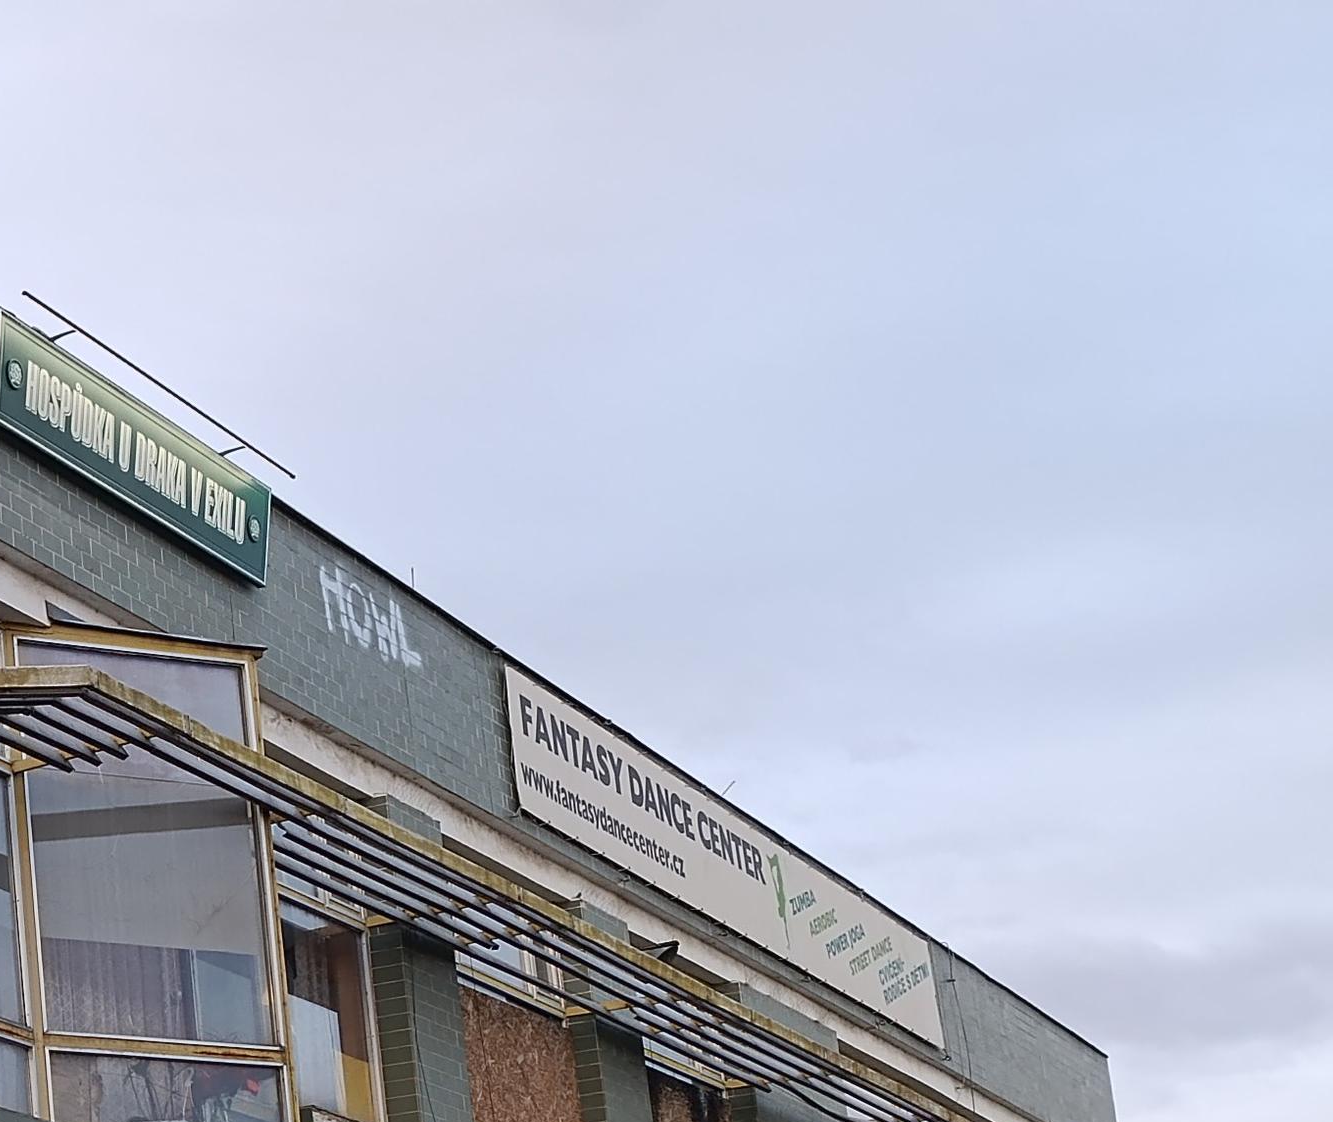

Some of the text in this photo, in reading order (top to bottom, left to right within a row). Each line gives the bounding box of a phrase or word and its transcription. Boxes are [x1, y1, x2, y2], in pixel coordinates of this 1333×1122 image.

[25, 360, 247, 546] HOSPŮDKA U DRAKA V EXILU
[318, 564, 423, 668] HOWL
[518, 693, 767, 886] FANTASY DANCE CENTER
[520, 761, 687, 879] www.fantasydancecenter.cz
[789, 889, 817, 916] ZUMBA
[808, 908, 838, 937] AEROBIC
[825, 932, 849, 960] POWER
[848, 936, 893, 977] STREET DANCE
